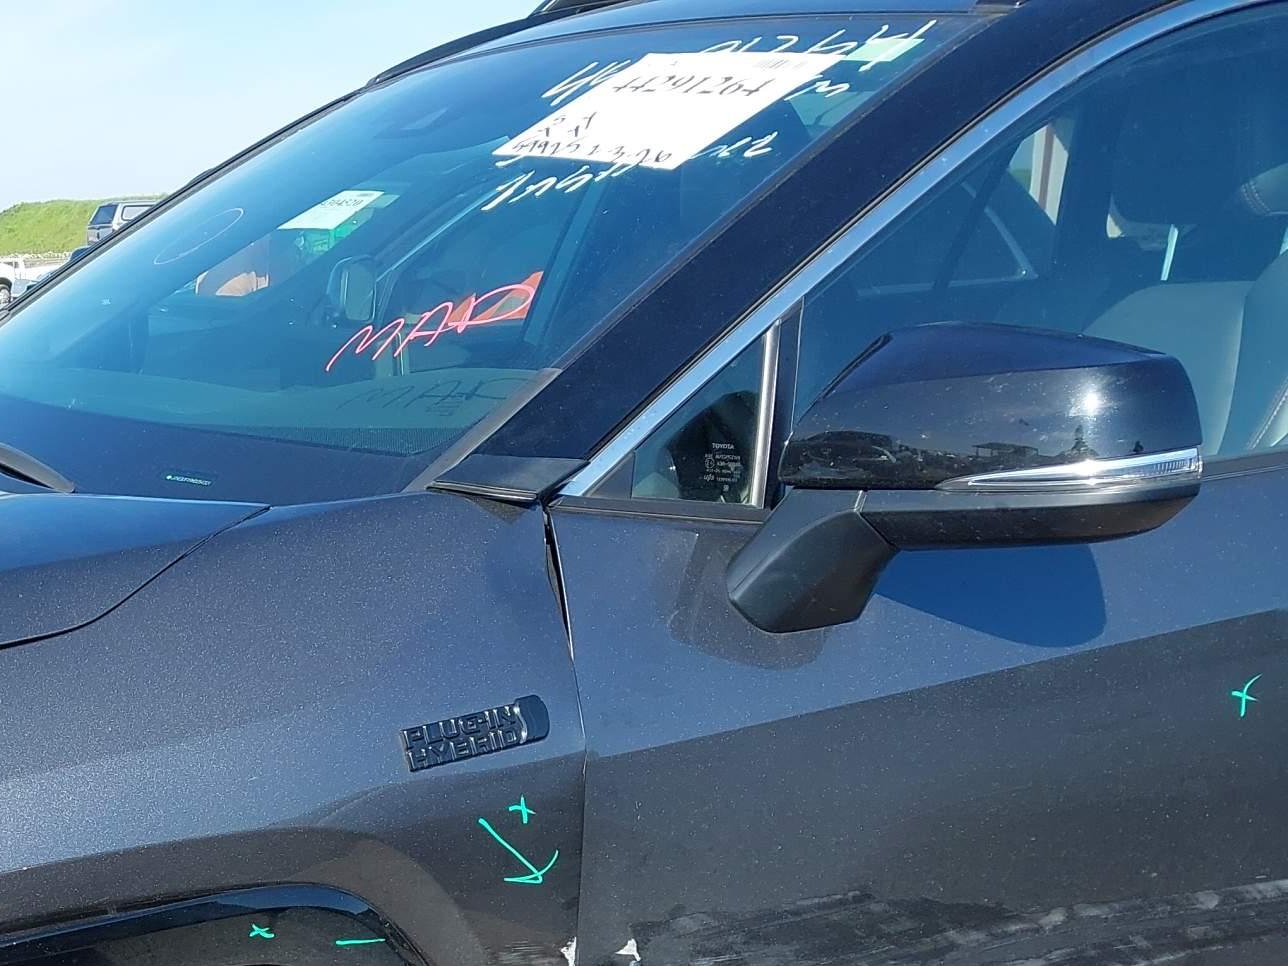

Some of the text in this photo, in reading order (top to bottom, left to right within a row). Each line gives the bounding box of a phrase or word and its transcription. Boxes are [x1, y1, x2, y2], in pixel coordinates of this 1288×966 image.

[612, 75, 775, 96] 44291264
[400, 705, 517, 749] PLUG-IN
[406, 730, 518, 771] HYBRID
